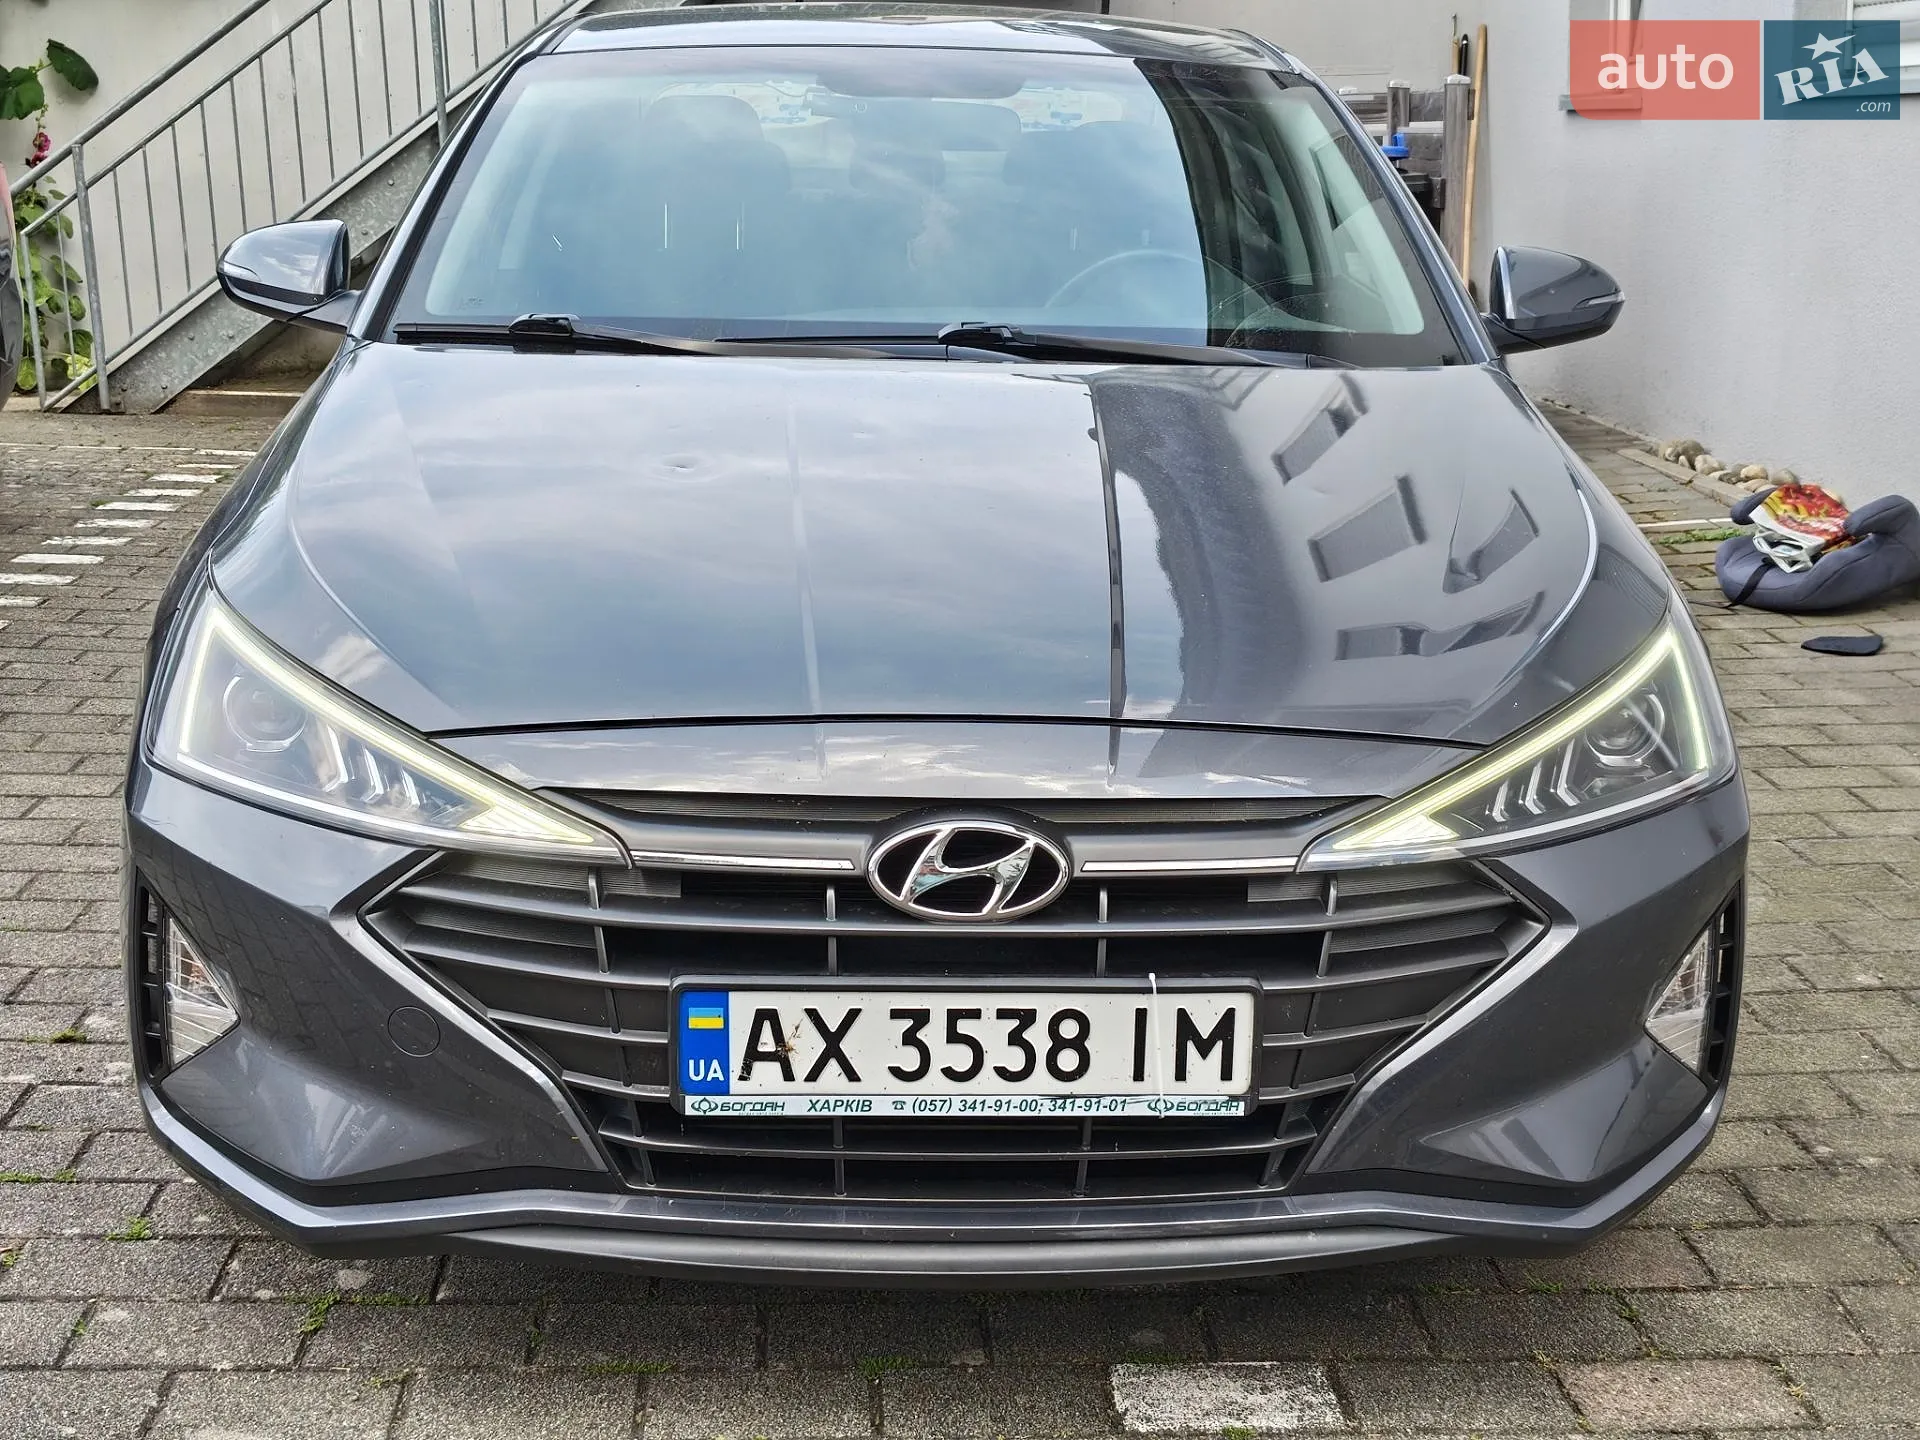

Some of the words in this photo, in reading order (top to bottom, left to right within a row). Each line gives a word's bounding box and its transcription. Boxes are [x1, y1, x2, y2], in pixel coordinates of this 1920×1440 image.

[737, 1007, 863, 1082] AX
[887, 1007, 1091, 1082] 3538
[1132, 1007, 1236, 1082] IM
[688, 1059, 725, 1081] UA
[719, 1101, 785, 1112] БОГДАН
[806, 1099, 873, 1113] ХАРКІВ
[911, 1098, 953, 1114] (057)
[957, 1098, 1043, 1114] 341-91-00;
[1048, 1098, 1128, 1112] 341-91-01
